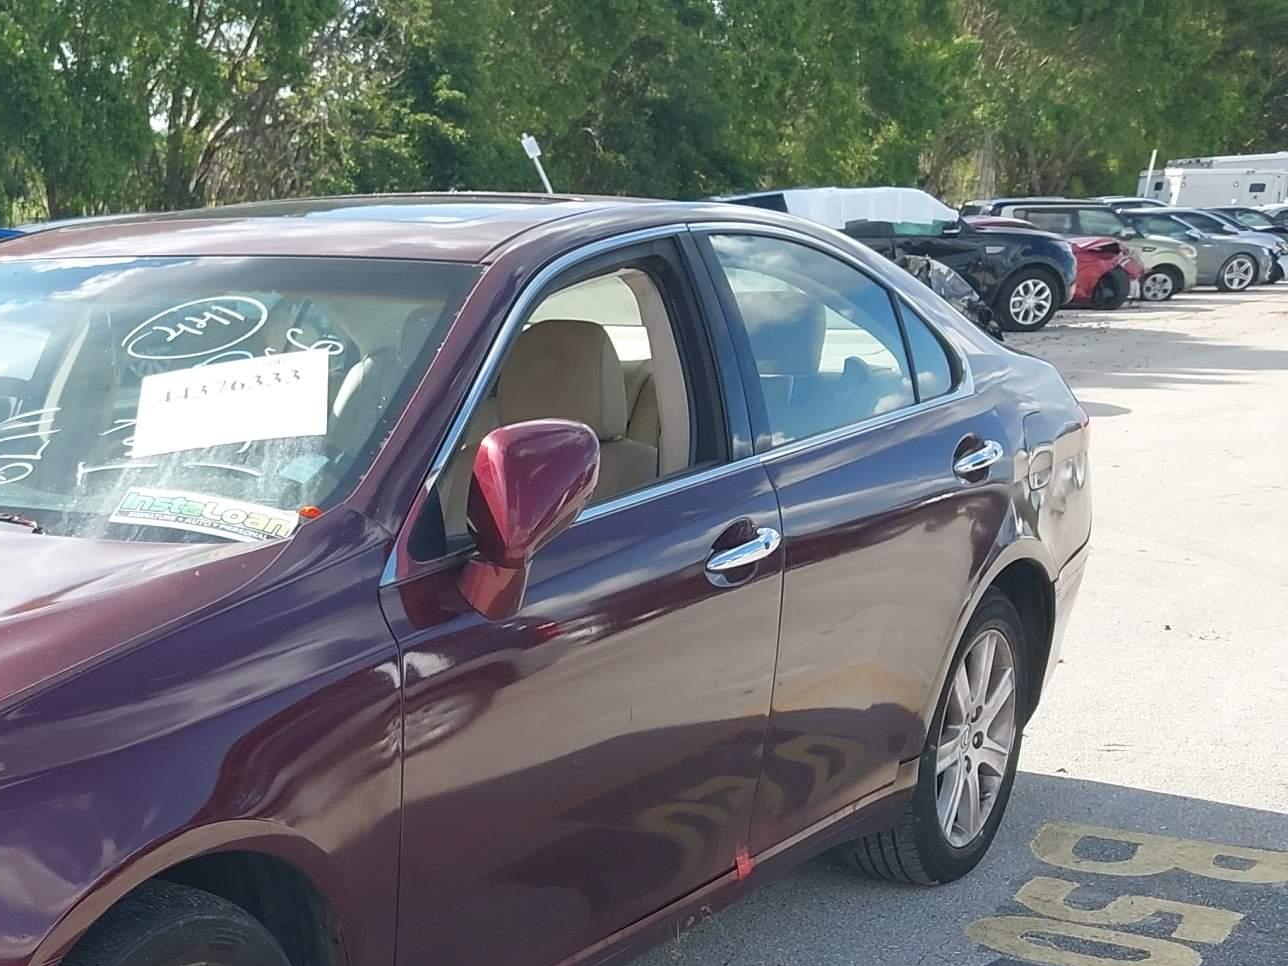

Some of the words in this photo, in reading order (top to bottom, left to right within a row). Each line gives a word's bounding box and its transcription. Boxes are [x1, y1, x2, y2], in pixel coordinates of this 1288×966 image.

[120, 491, 292, 539] InstaLoan
[184, 516, 213, 528] AUTO
[218, 523, 269, 541] PERSONAL
